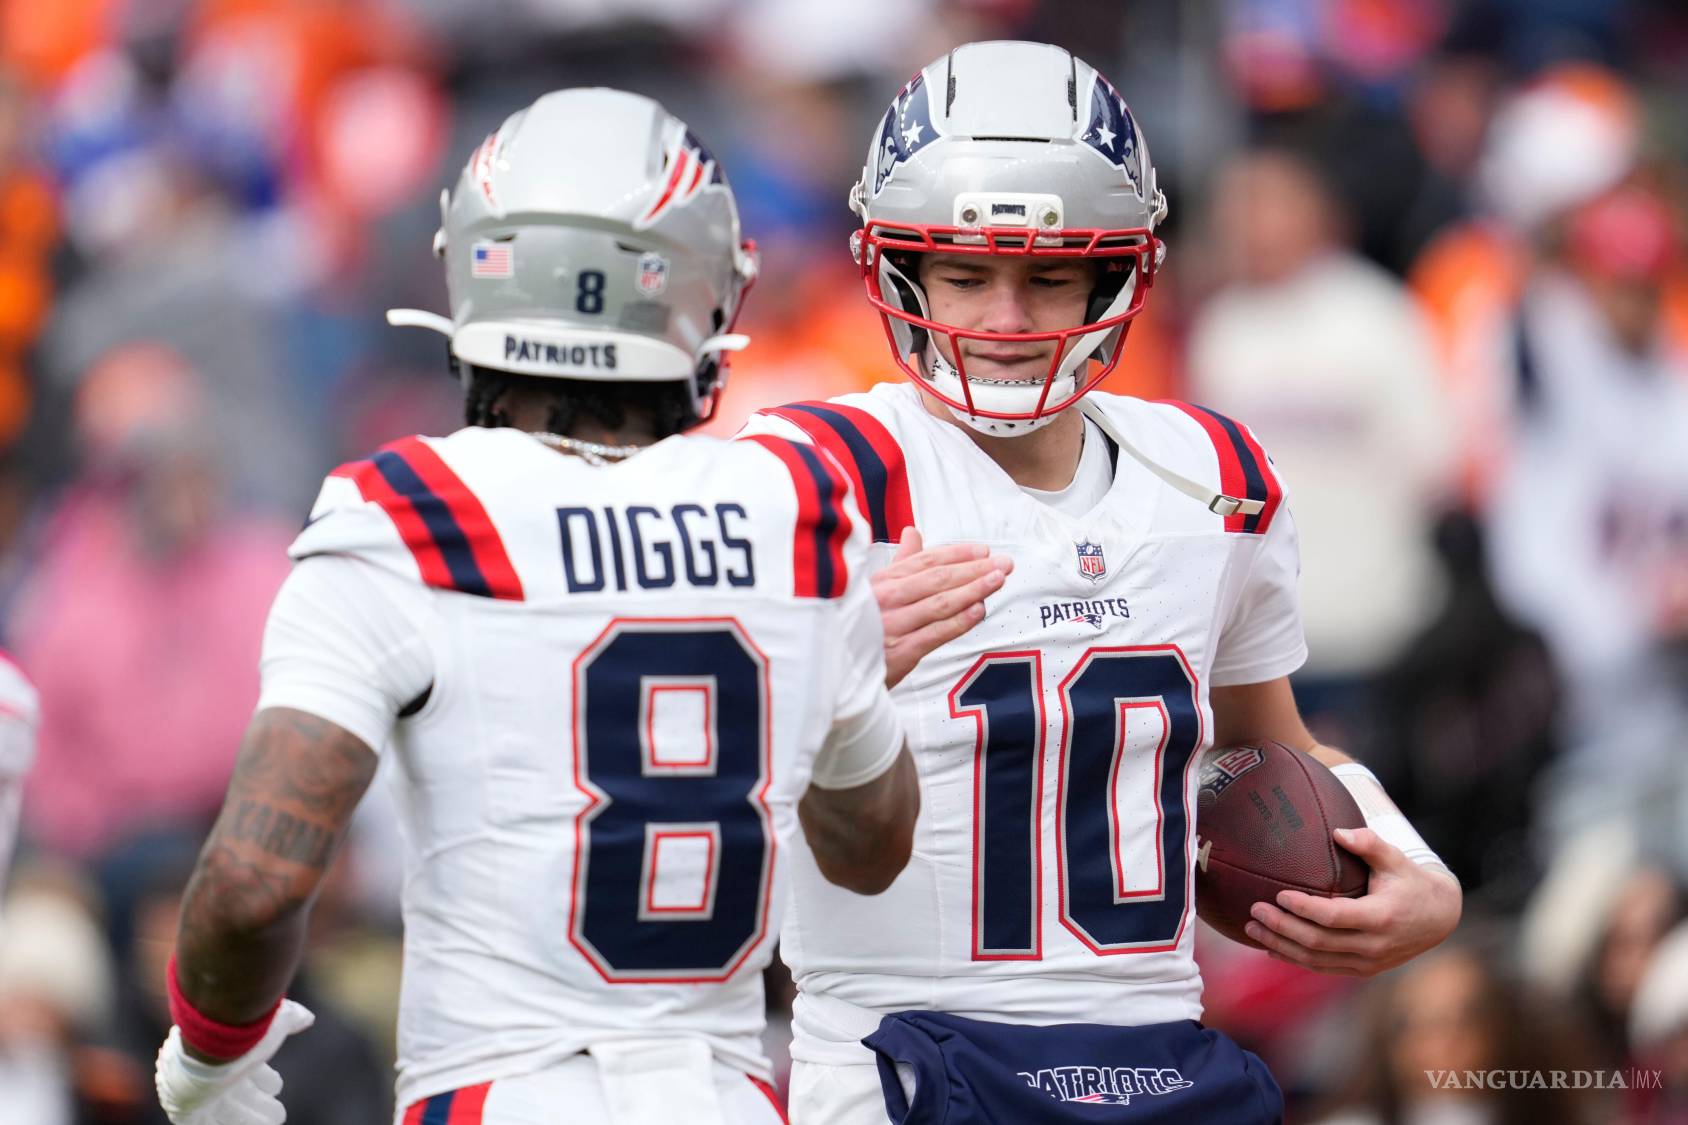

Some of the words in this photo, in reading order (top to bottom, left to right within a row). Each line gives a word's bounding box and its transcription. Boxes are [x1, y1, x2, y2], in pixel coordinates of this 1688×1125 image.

[576, 269, 605, 314] 8
[505, 335, 616, 369] PATRIOTS
[556, 502, 756, 594] DIGGS
[1081, 556, 1104, 574] NFL
[1040, 597, 1130, 628] PATRIOTS
[568, 616, 777, 984] 8
[947, 643, 1204, 962] 10
